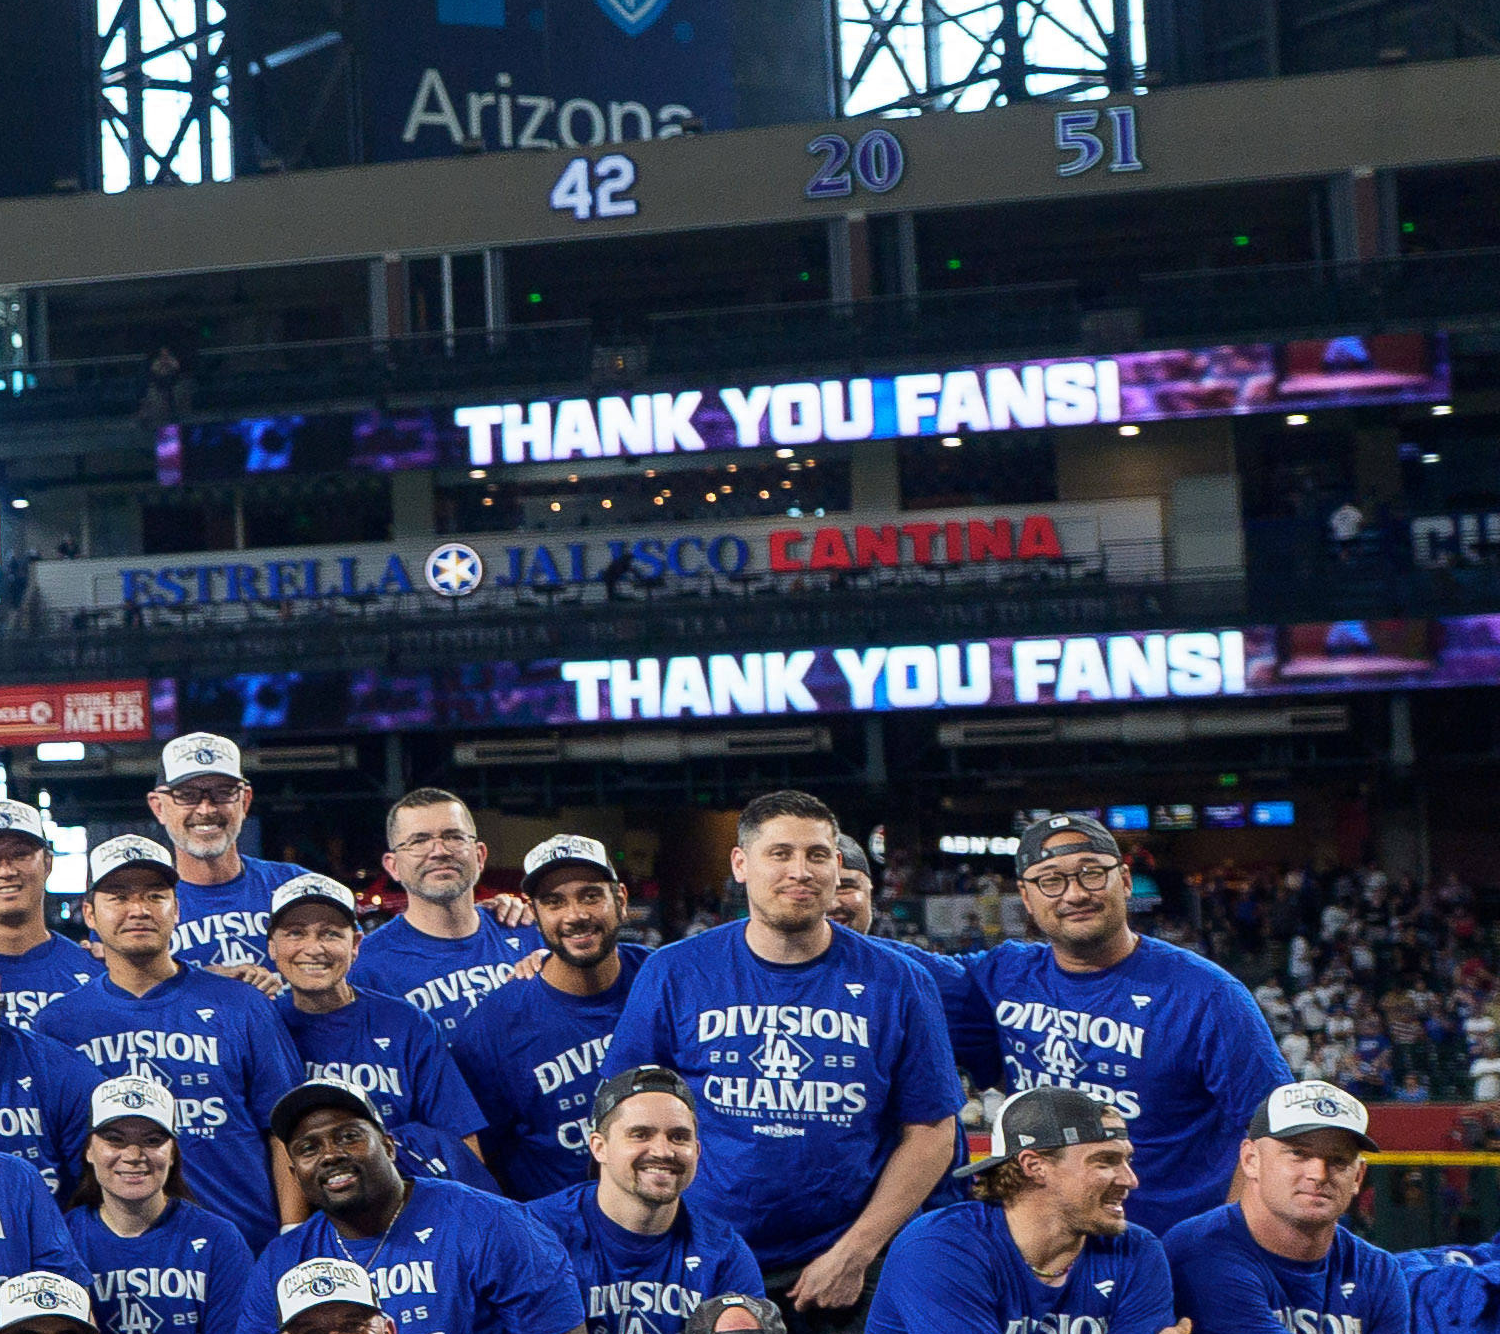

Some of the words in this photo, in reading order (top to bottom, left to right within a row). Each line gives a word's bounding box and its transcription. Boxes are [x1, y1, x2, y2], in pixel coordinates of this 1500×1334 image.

[804, 128, 904, 198] 20
[1054, 105, 1144, 176] 51
[550, 153, 638, 219] 42
[455, 391, 704, 468] THANK
[718, 379, 870, 450] YOU
[893, 360, 1120, 438] FANS!
[118, 554, 412, 608] ESTRELLA
[767, 515, 1062, 574] CANTINA
[560, 653, 830, 724] THANK
[835, 641, 992, 712] YOU
[1013, 630, 1247, 703] FANS!
[63, 703, 145, 733] METER
[700, 1005, 870, 1048] DIVISION
[710, 1050, 740, 1064] 20
[824, 1054, 856, 1069] 25
[703, 1074, 867, 1117] CHAMPS
